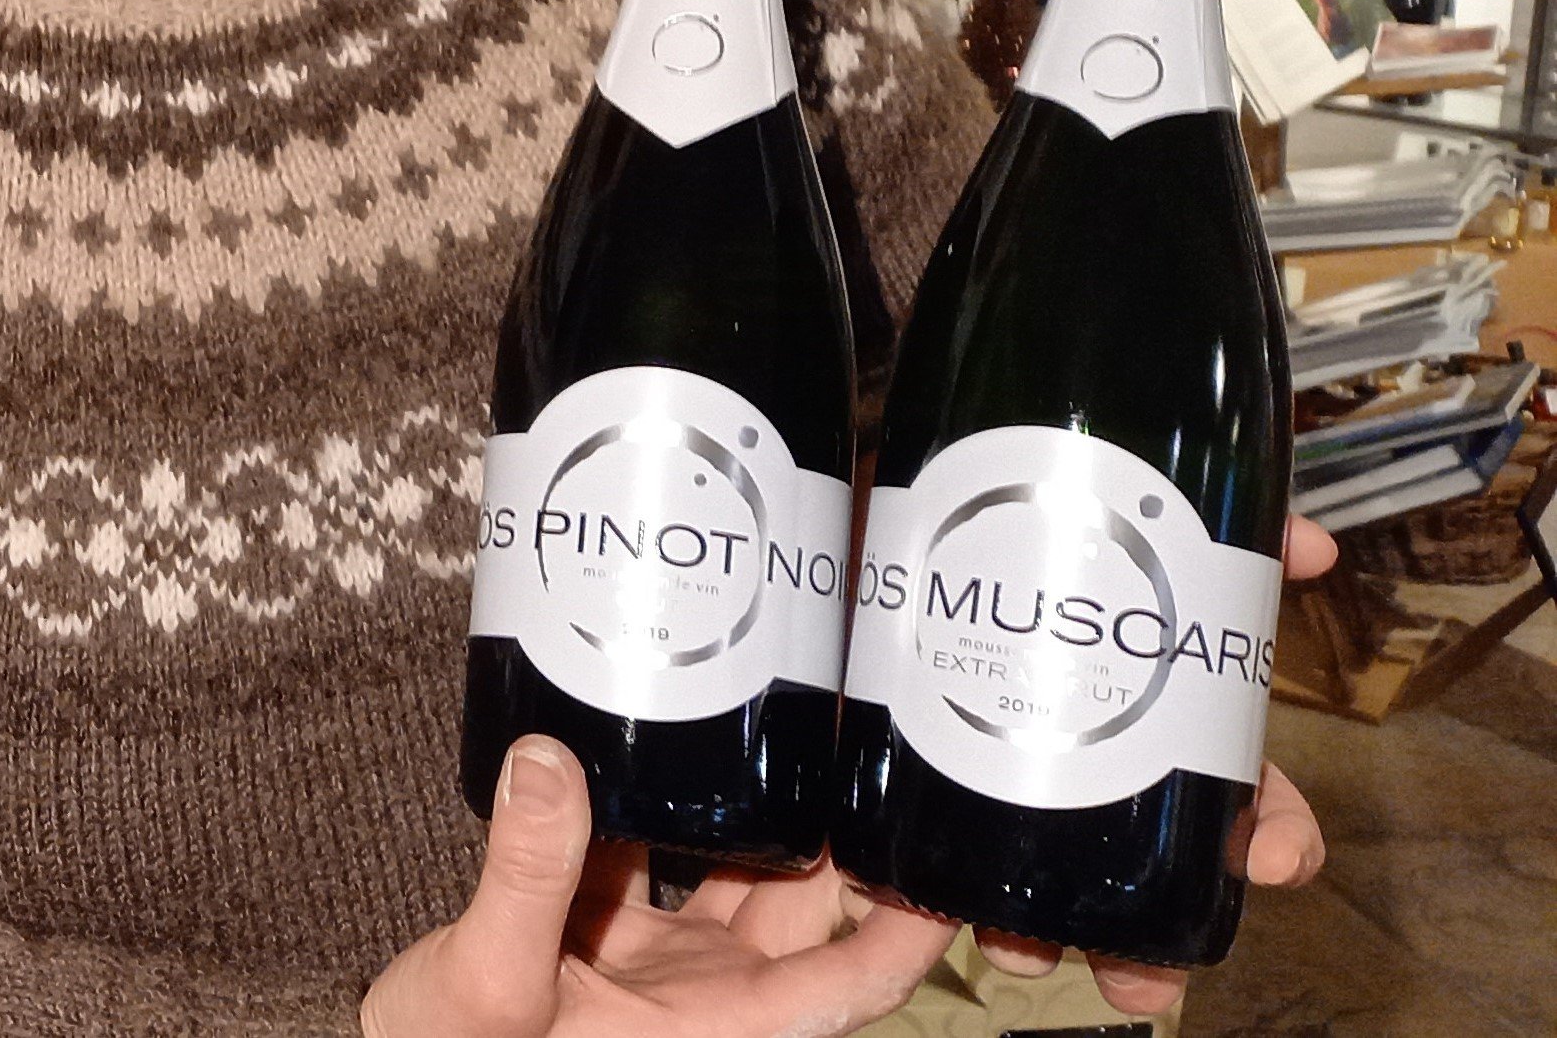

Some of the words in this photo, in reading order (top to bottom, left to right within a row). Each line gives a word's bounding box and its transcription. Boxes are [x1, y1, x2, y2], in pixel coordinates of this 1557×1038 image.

[478, 502, 515, 549] ÖS
[535, 509, 749, 575] PINOT
[767, 540, 844, 601] NOI
[696, 582, 719, 597] vin
[859, 552, 908, 610] ÖS
[926, 571, 1274, 688] MUSCARIS
[933, 650, 1030, 687] EXTR
[1064, 676, 1133, 705] RUT
